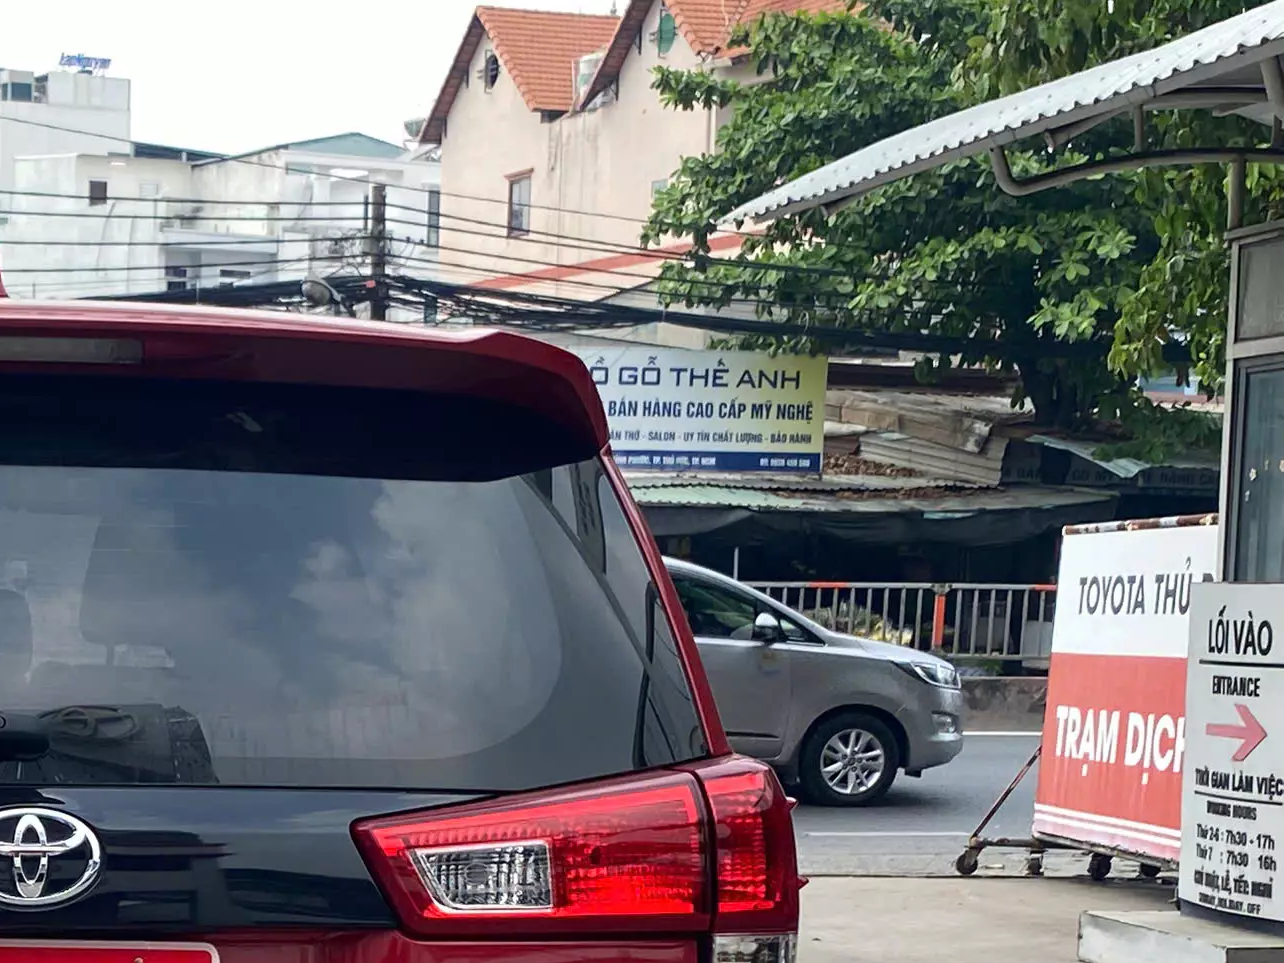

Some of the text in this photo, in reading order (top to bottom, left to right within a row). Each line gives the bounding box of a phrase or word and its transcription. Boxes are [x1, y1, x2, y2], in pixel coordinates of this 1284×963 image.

[618, 356, 661, 386] GỖ
[669, 358, 730, 388] THẾ
[736, 369, 801, 390] ANH
[608, 395, 637, 417] BÁN
[642, 397, 682, 418] HÀNG
[686, 401, 714, 419] CAO
[718, 396, 747, 419] CẤP
[776, 400, 813, 425] NGHỆ
[647, 430, 676, 441] SALON
[683, 431, 695, 442] UY
[1079, 556, 1192, 616] TOYOTA THỦ
[1208, 604, 1274, 656] LỐI VÀO
[1212, 675, 1261, 698] ENTRANCE
[1056, 705, 1120, 777] TRẠM
[1232, 770, 1253, 793] LÀM
[1257, 773, 1284, 800] VIỆC
[1226, 829, 1247, 846] 7h30
[1256, 833, 1275, 850] 17h
[1227, 850, 1249, 867] 7h30
[1258, 855, 1277, 872] 16h
